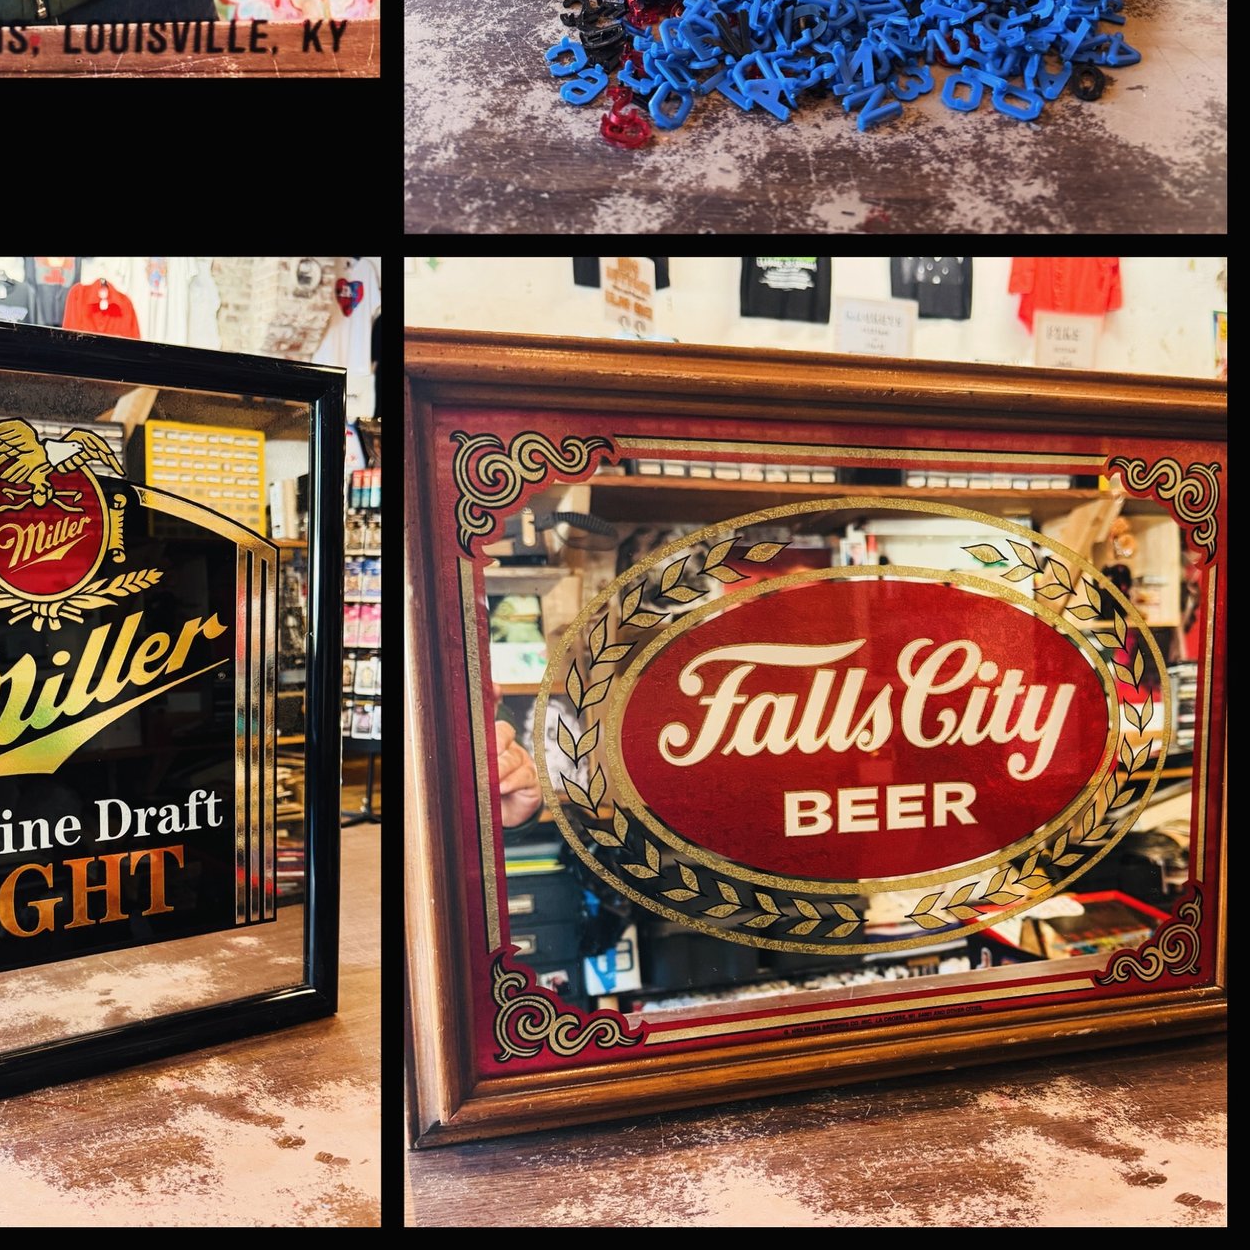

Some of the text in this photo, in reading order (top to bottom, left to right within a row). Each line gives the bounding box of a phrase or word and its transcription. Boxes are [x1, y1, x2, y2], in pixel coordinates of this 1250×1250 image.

[63, 19, 279, 56] LOUISVILLE,
[302, 18, 349, 54] KY
[658, 637, 1077, 782] Falls City
[94, 789, 224, 843] Draft
[784, 781, 979, 838] BEER
